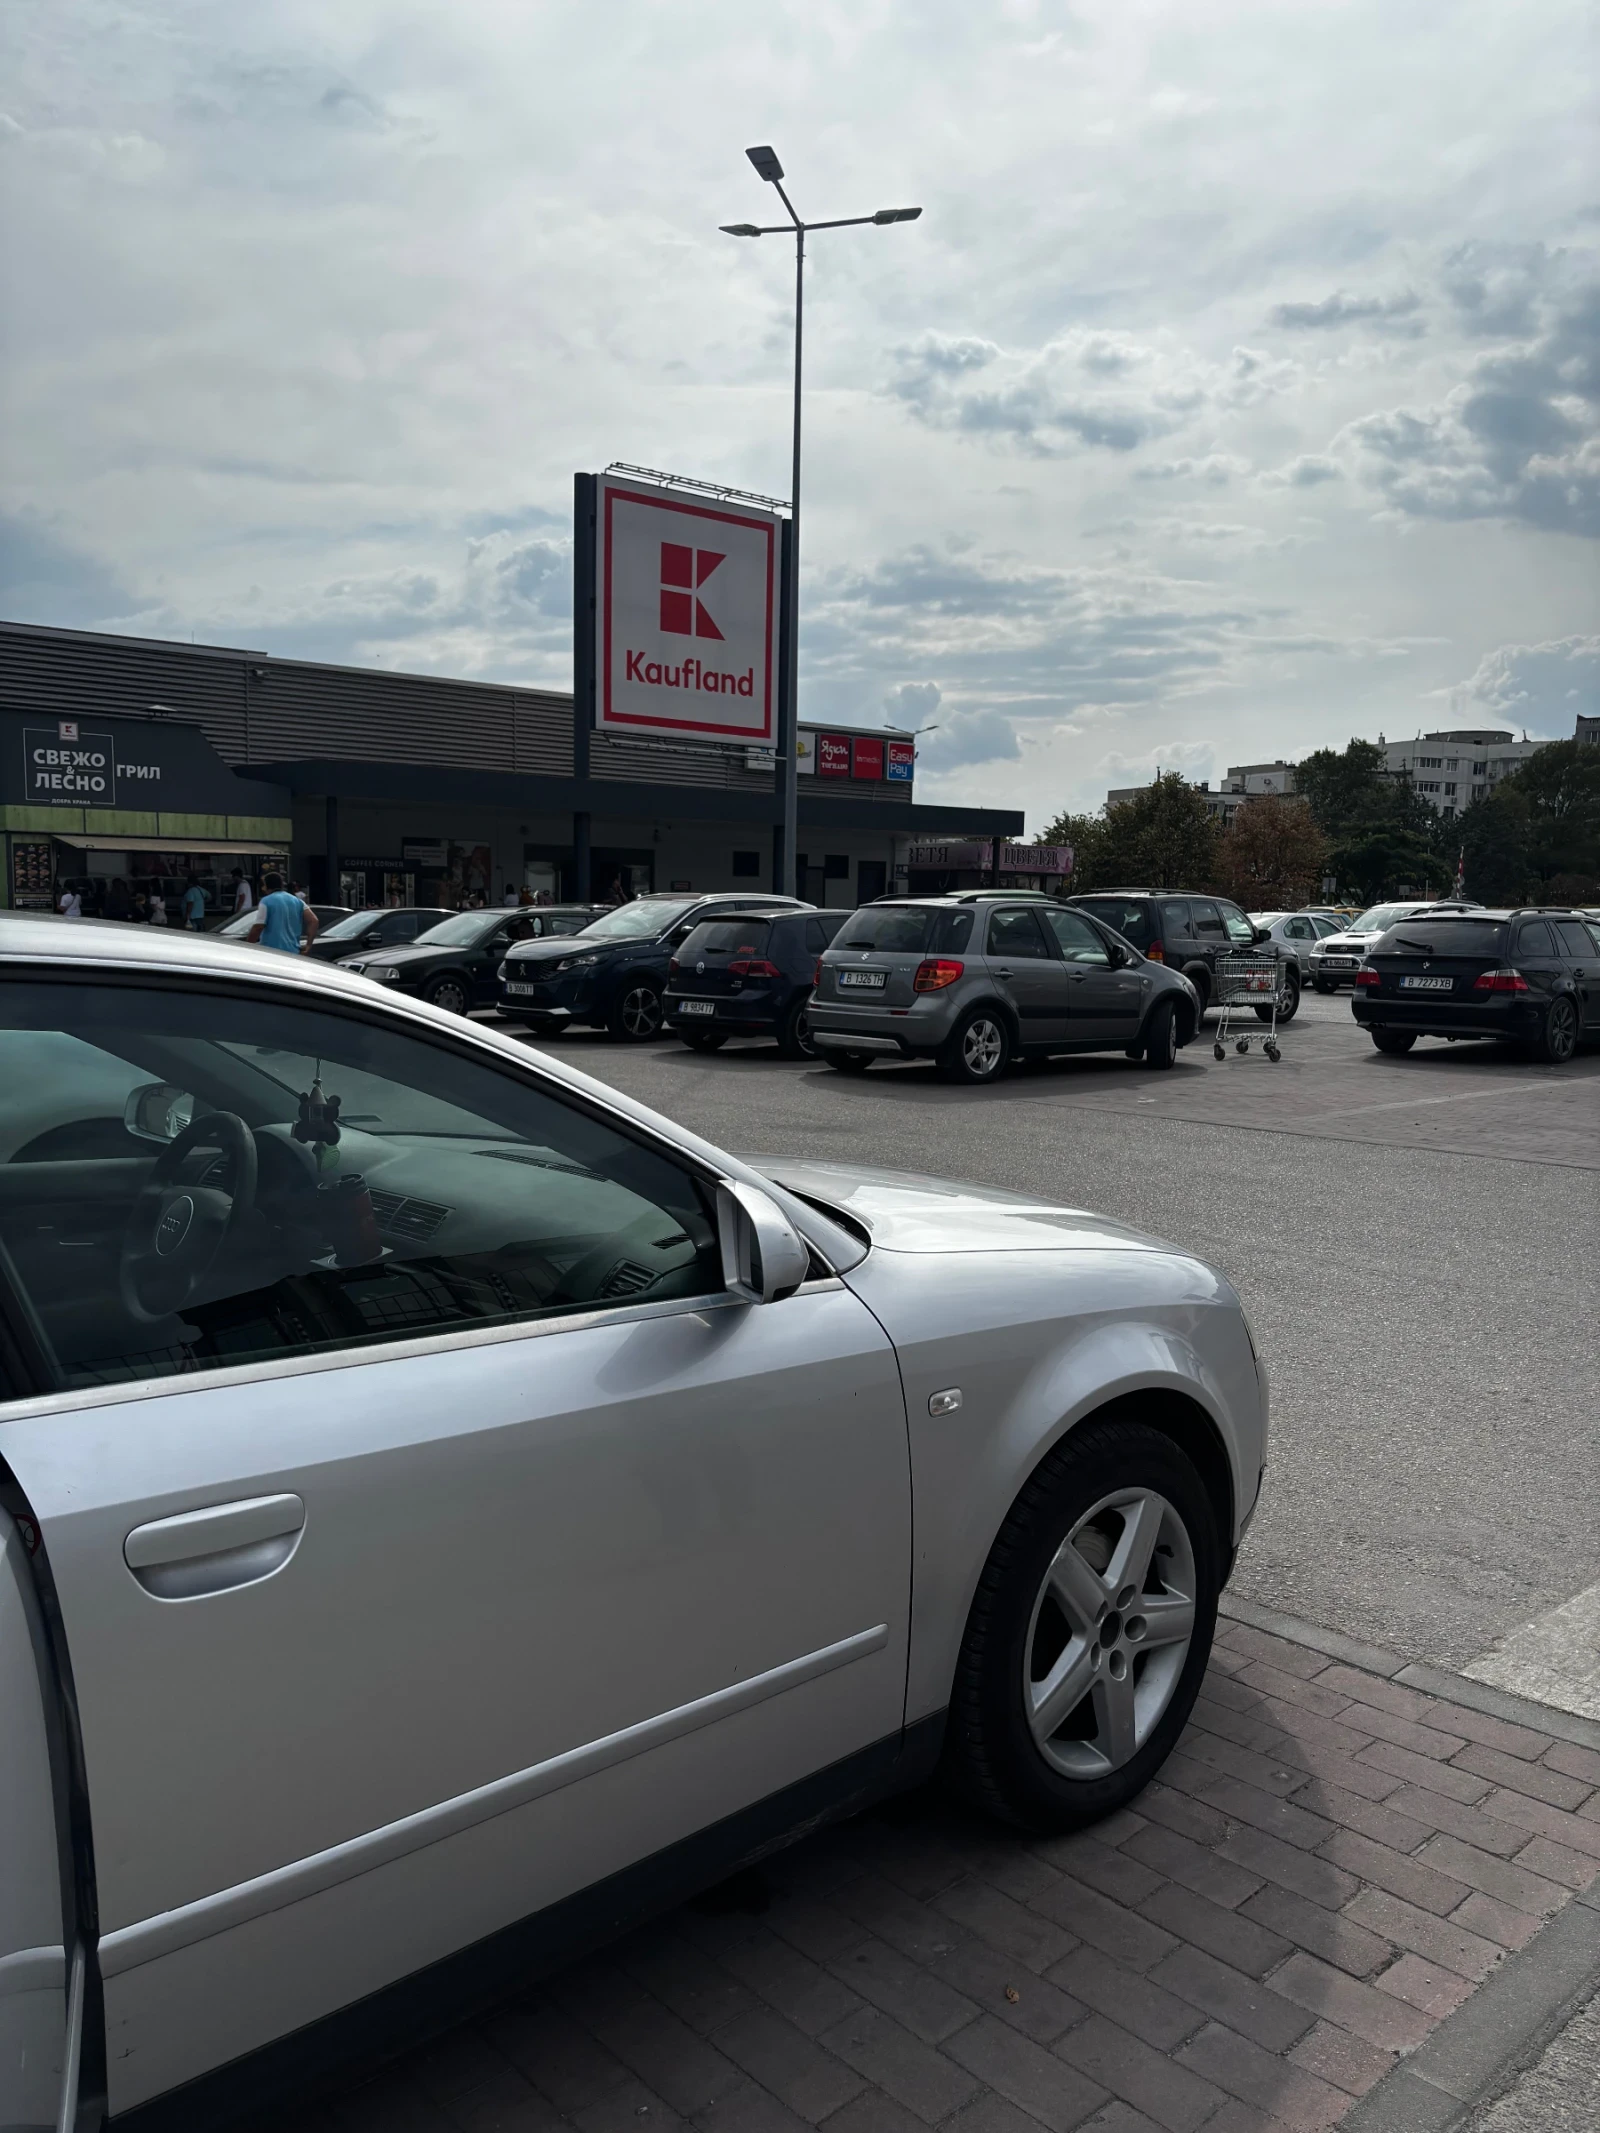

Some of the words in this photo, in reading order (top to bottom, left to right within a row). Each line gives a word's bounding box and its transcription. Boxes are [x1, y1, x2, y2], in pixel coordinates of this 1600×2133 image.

[626, 649, 754, 697] Kaufland
[33, 748, 106, 767] СВЕЖО
[890, 749, 913, 765] Easy
[66, 765, 75, 775] &
[116, 764, 161, 780] ГРИЛ
[889, 764, 908, 777] Pay
[35, 772, 106, 792] ЛЕСНО
[344, 859, 372, 867] COFFEE
[374, 860, 404, 868] CORNER
[1003, 847, 1057, 869] ЦВЕТЯ
[846, 974, 852, 983] B
[855, 973, 872, 984] 1326
[873, 975, 883, 985] TH
[1408, 979, 1414, 987] B
[1417, 979, 1438, 988] 7273
[1439, 980, 1451, 988] XB
